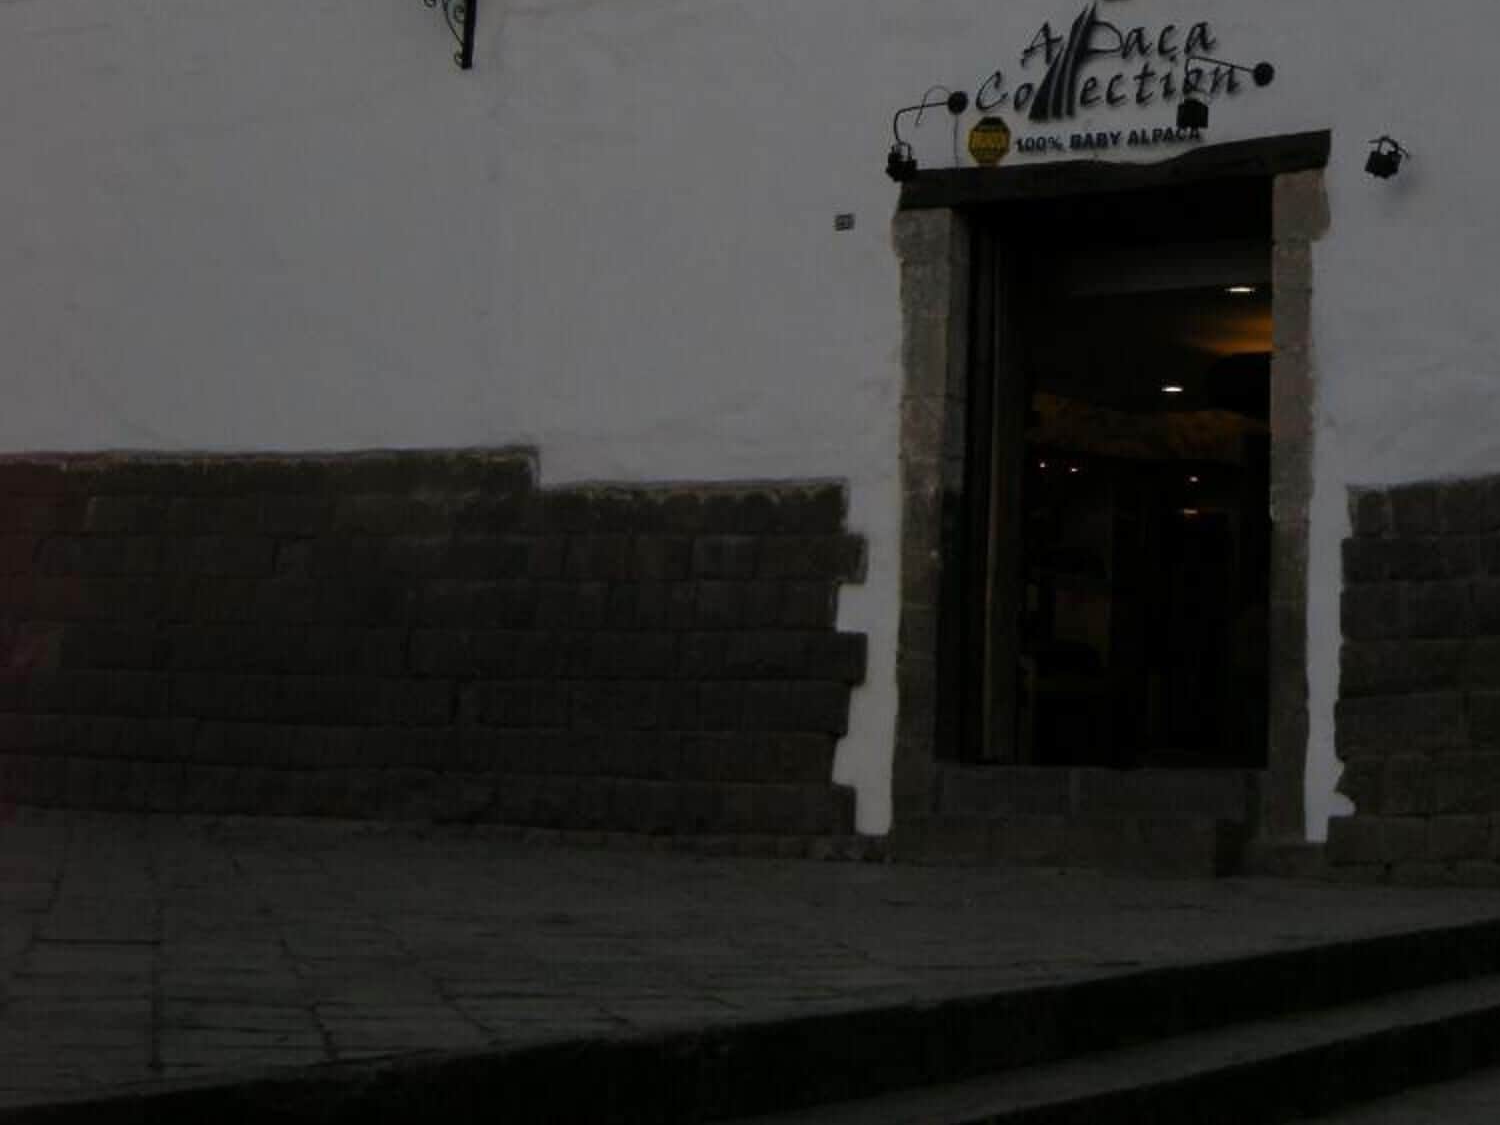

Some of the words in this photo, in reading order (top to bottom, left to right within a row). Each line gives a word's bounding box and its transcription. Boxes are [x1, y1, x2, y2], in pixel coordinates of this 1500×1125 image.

[975, 53, 1242, 121] Collection
[1017, 135, 1064, 153] 100%
[1070, 131, 1122, 149] BABY
[1127, 126, 1202, 146] ALPACA
